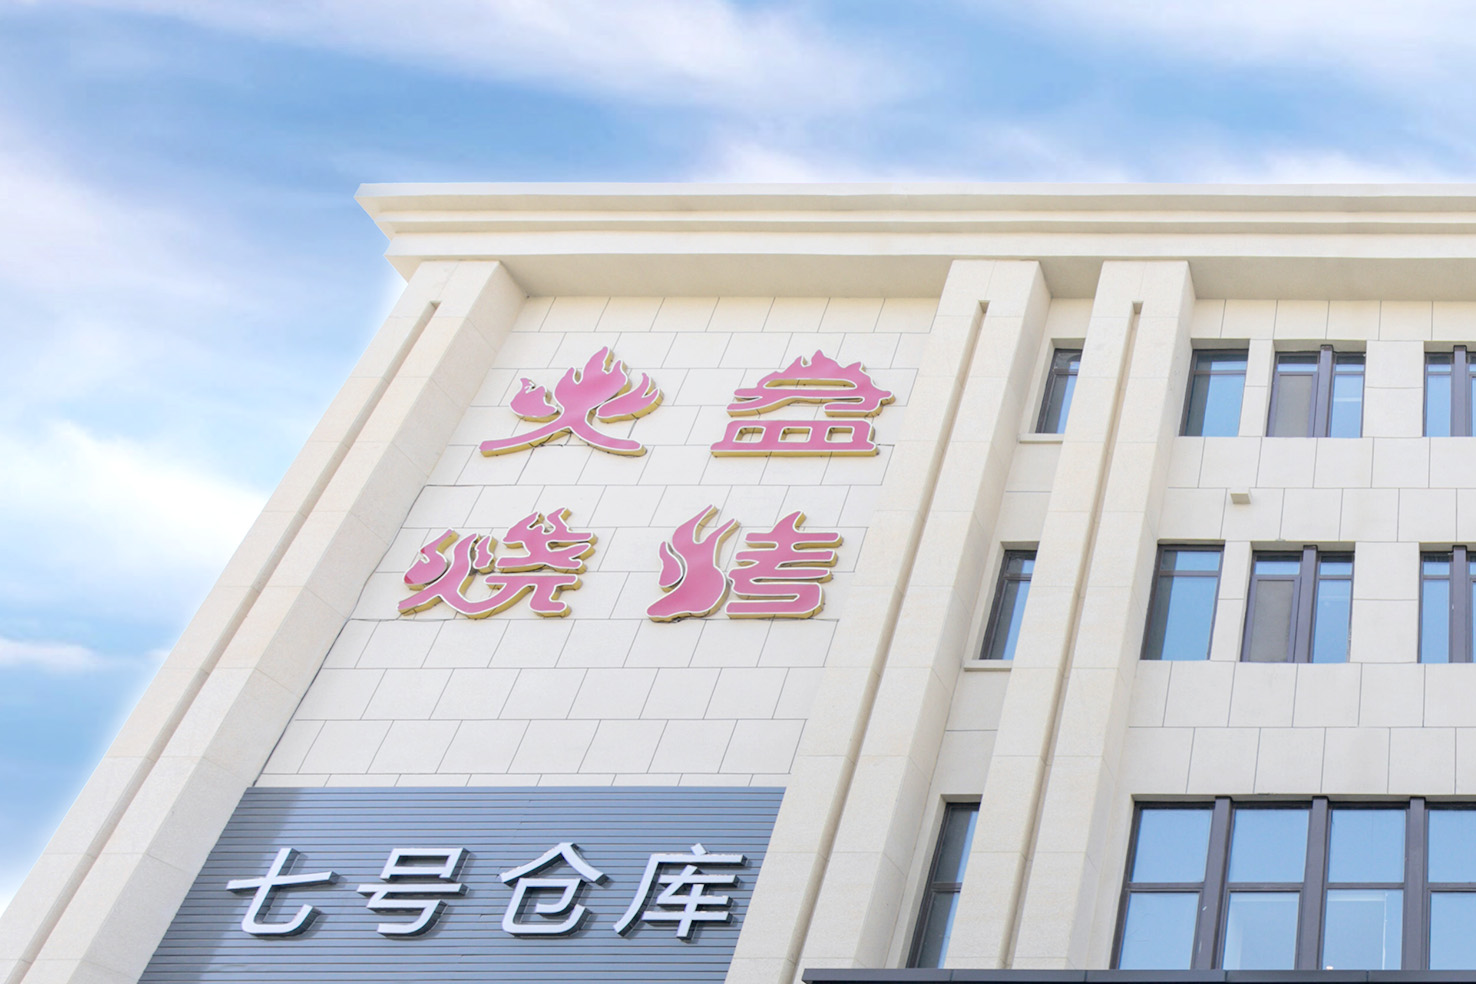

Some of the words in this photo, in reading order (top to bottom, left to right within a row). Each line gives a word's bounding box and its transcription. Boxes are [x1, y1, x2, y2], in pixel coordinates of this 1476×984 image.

[397, 504, 844, 623] 烧烤
[226, 842, 749, 940] 七号仓库
